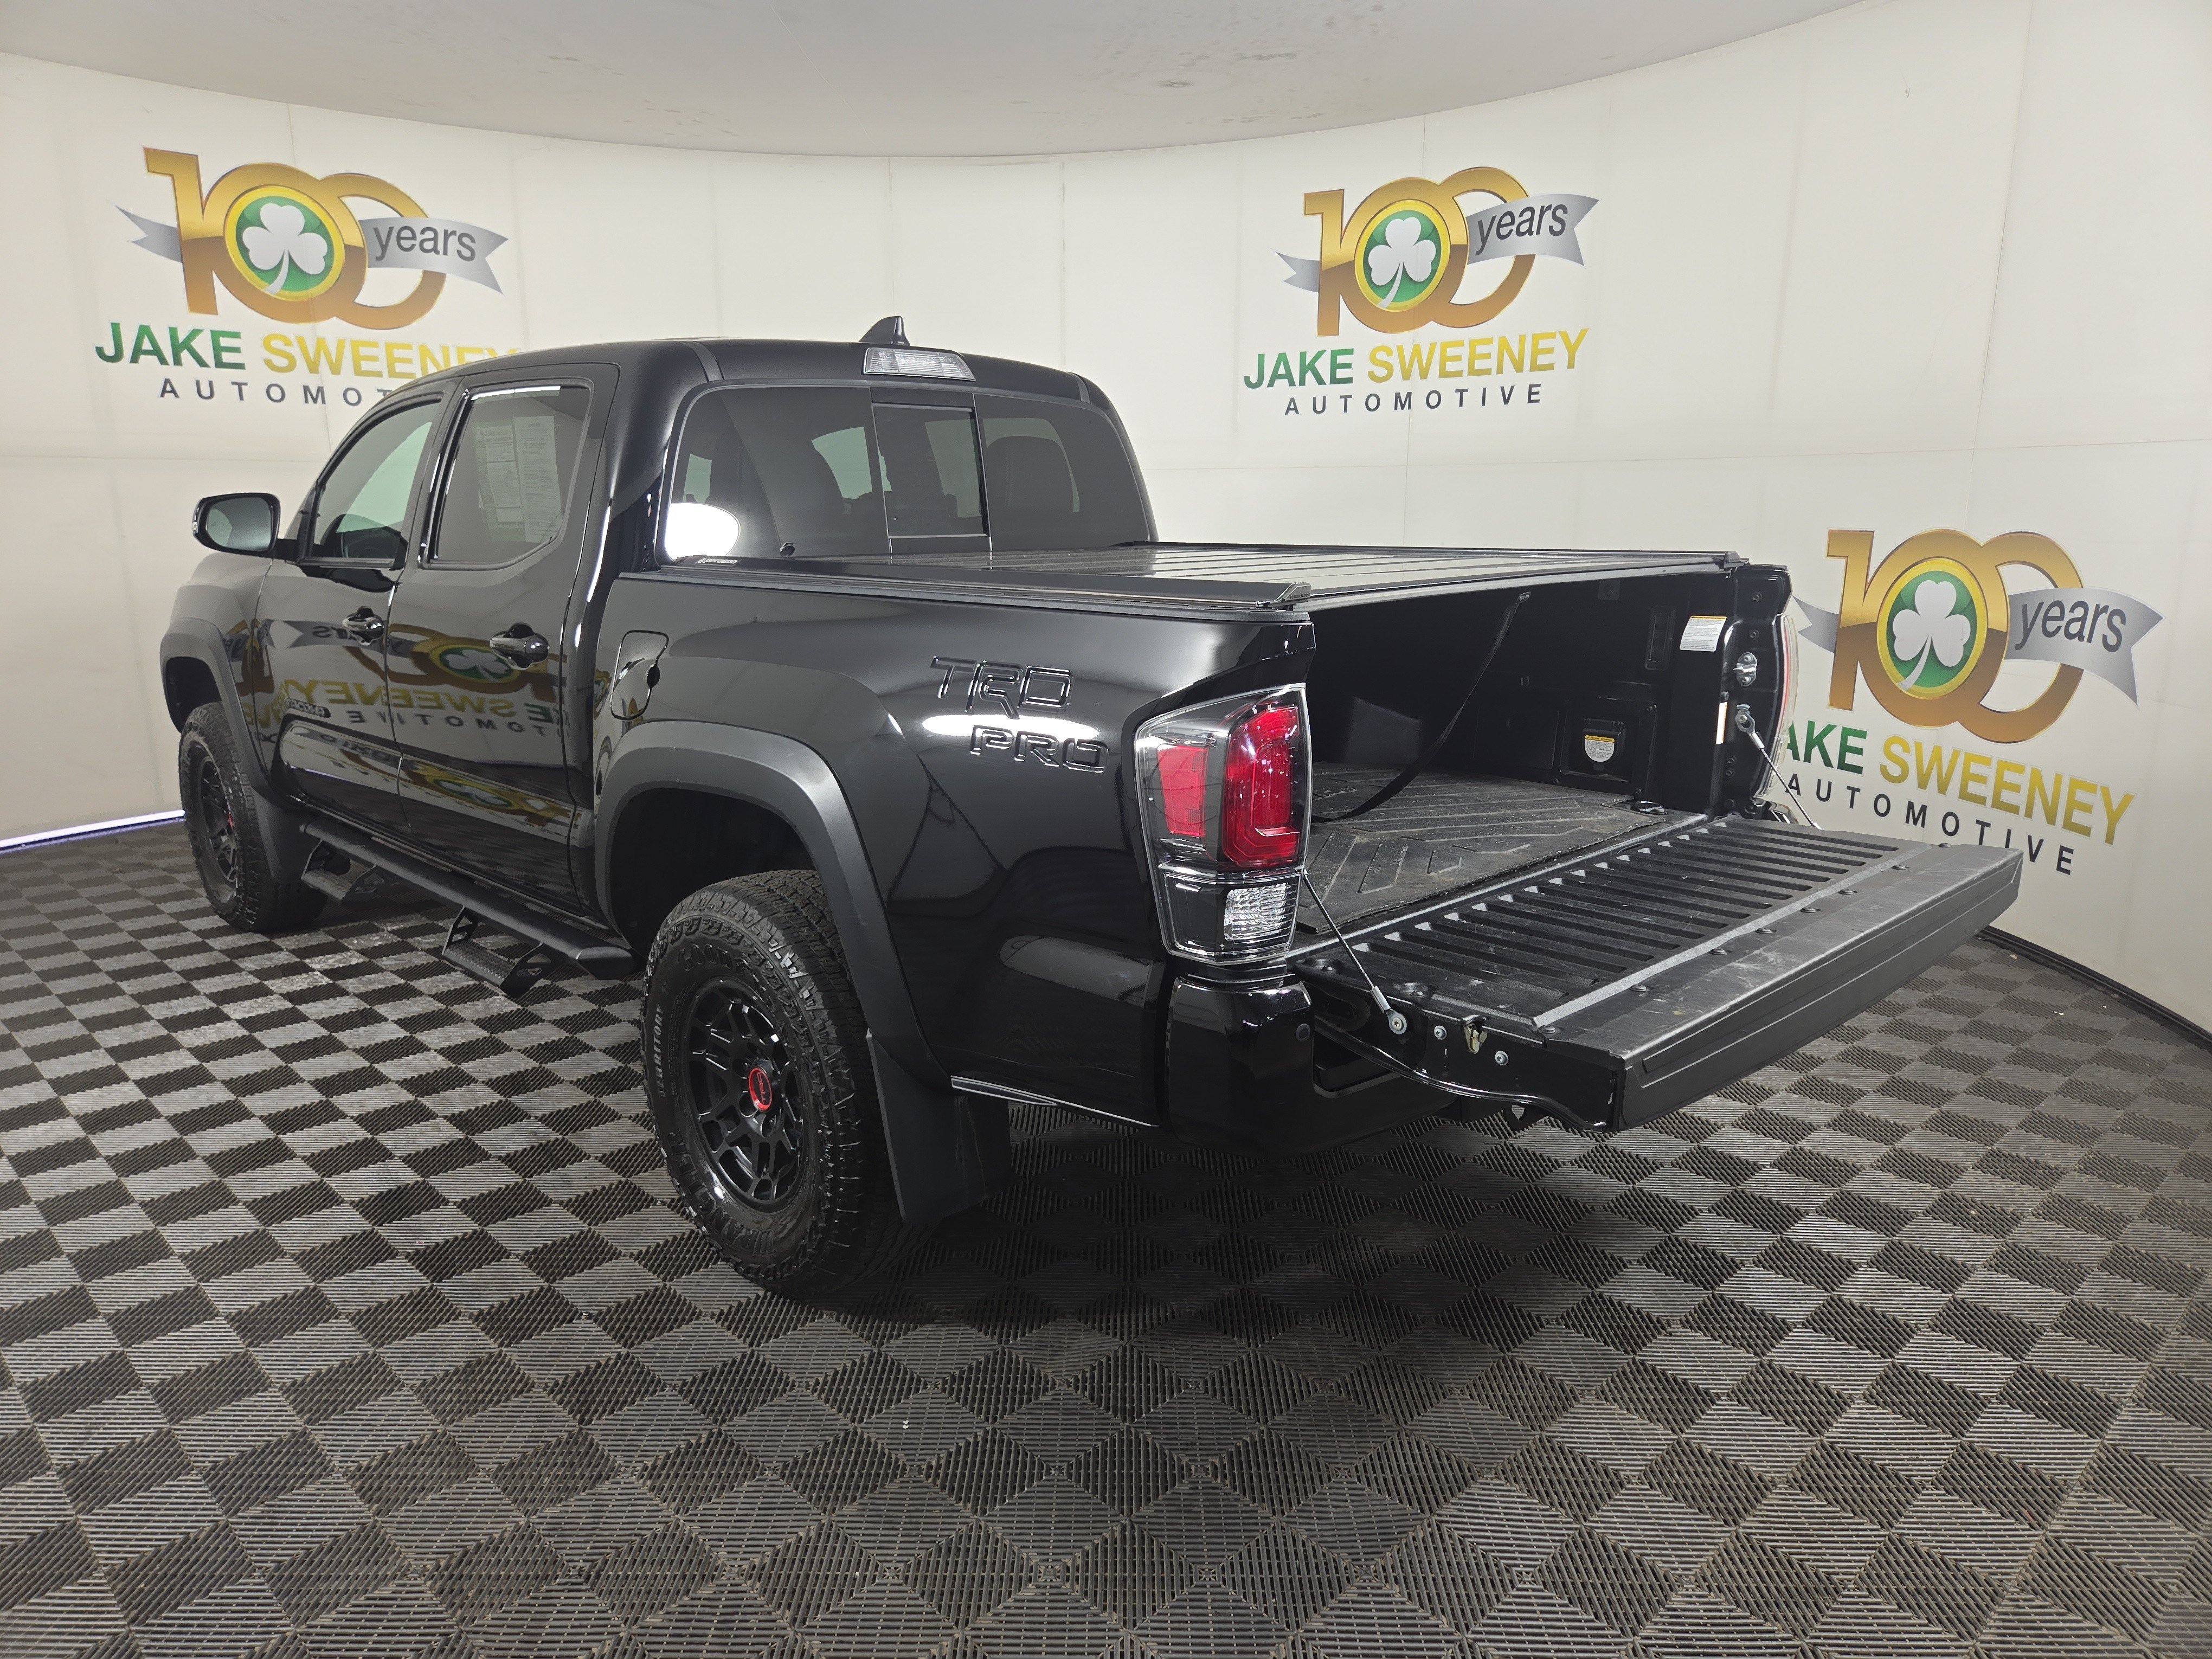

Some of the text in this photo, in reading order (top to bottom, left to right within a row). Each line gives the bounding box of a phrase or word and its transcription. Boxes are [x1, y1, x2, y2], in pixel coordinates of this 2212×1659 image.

[143, 146, 477, 330] 100 years
[1304, 166, 1568, 336] 100 years
[95, 322, 519, 379] JAKE SWEEN
[1244, 327, 1589, 389] JAKE SWEENEY
[159, 378, 393, 406] AUTOMOT
[1284, 383, 1542, 415] AUTOMOTIVE
[1826, 529, 2126, 743] 100 years
[930, 655, 1075, 719] TRD
[970, 725, 1109, 774] PRO
[1786, 720, 2135, 846] AKE SWEENEY
[1785, 773, 2074, 875] AUTOMOTIVE
